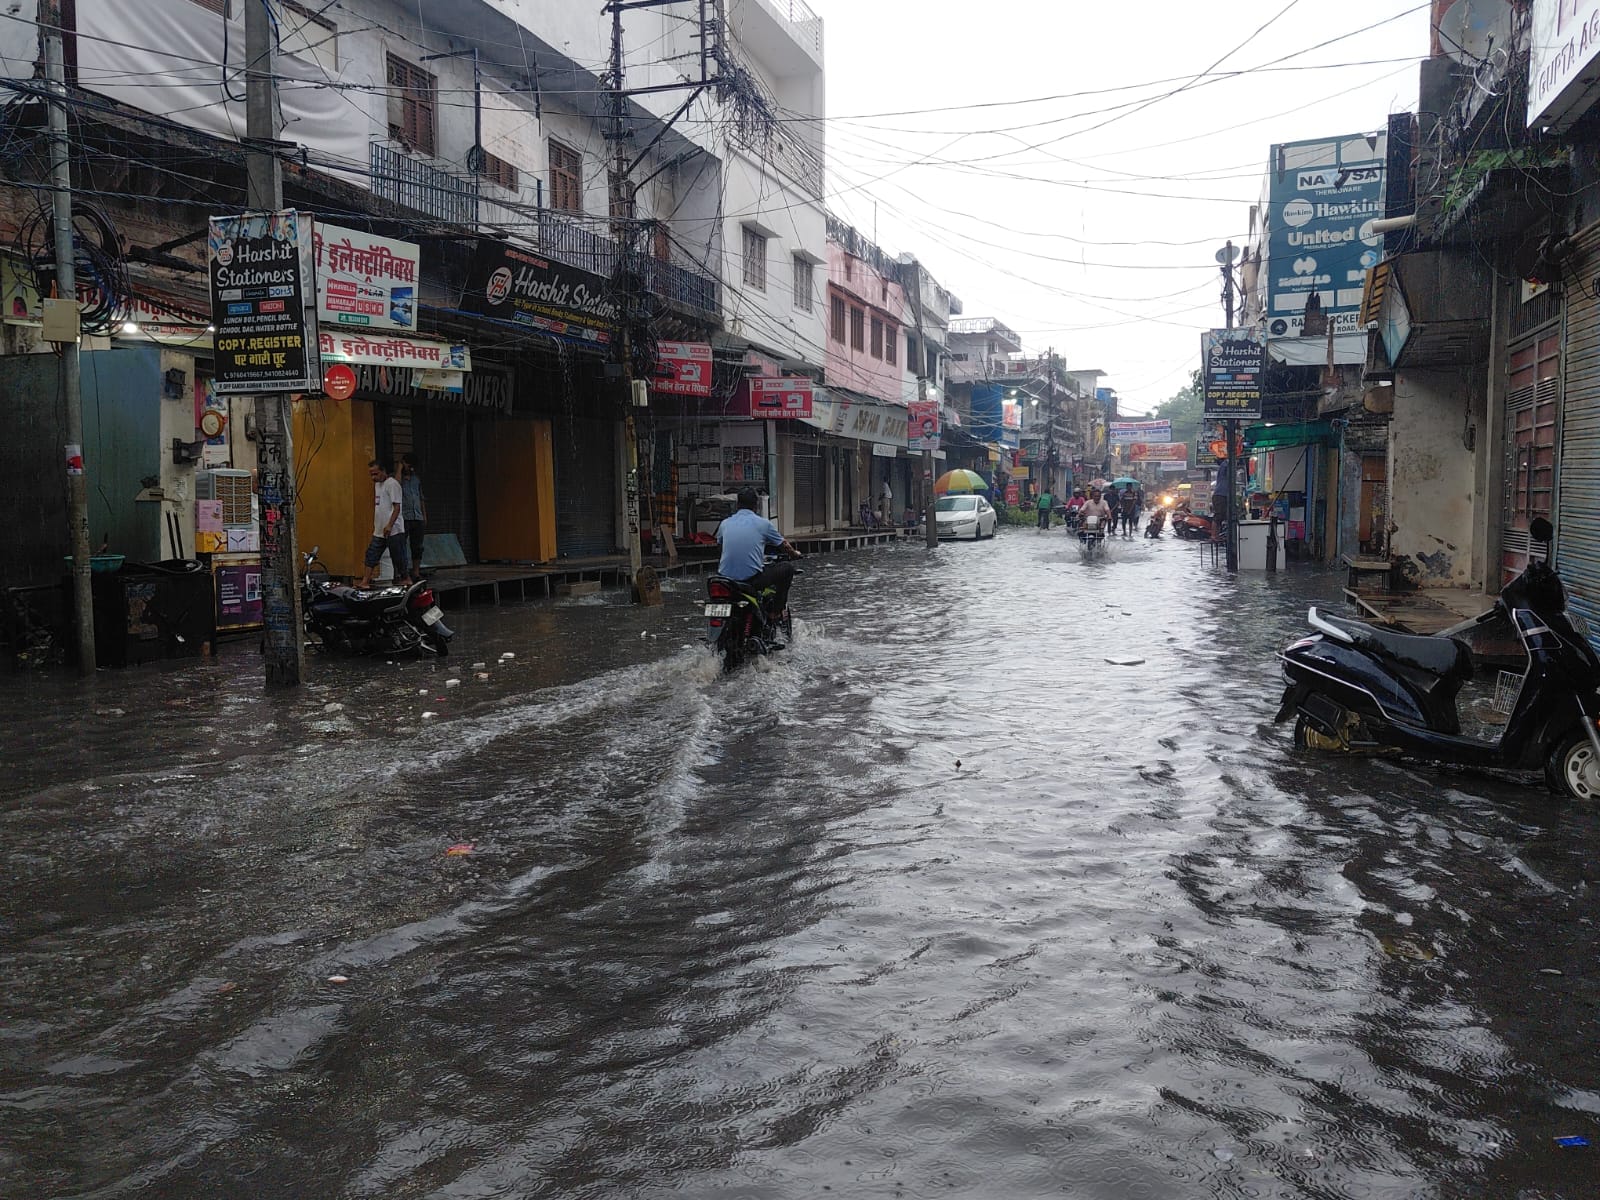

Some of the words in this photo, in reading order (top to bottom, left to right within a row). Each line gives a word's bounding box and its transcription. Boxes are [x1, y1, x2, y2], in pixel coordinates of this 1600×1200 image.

[1539, 36, 1575, 100] GUPTA
[1579, 8, 1600, 57] AG
[1300, 169, 1378, 187] NAYSA
[1317, 199, 1379, 217] Hawkin
[1288, 226, 1355, 246] United
[236, 241, 293, 263] Harshit
[216, 267, 294, 287] Stationers
[515, 266, 570, 305] Harshit
[358, 287, 383, 297] POLAR
[358, 302, 383, 313] USHA
[1291, 318, 1304, 328] RA
[1225, 345, 1261, 356] Harshit
[234, 354, 247, 366] पर
[1210, 356, 1261, 367] Stationers
